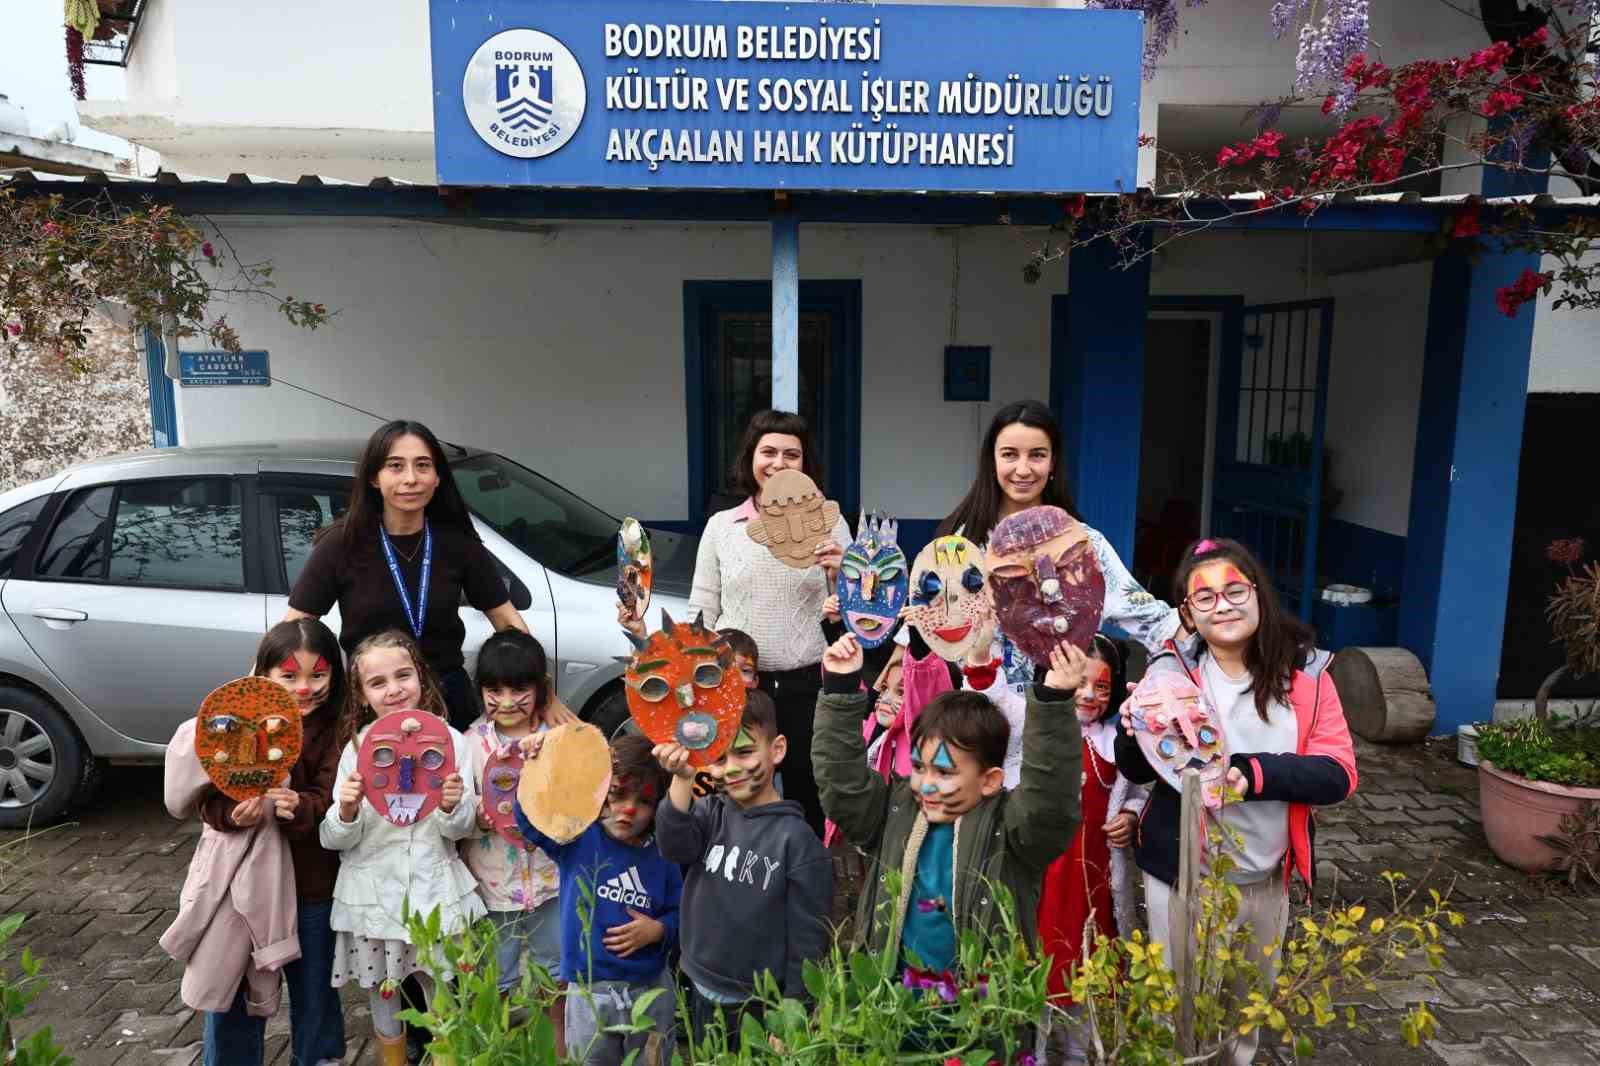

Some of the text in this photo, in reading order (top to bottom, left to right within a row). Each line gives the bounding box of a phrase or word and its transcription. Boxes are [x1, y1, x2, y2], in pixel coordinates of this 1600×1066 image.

[495, 51, 553, 61] BODRUM
[605, 18, 881, 61] BODRUM BELEDİYESİ
[606, 68, 1112, 121] KÜLTÜR VE SOSYAL İŞLER MÜDÜRLÜĞÜ
[489, 122, 561, 147] BELEDİYESİ
[606, 123, 1014, 171] AKÇAALAN HALK KÜTÜPHANESİ
[597, 885, 651, 909] adidas
